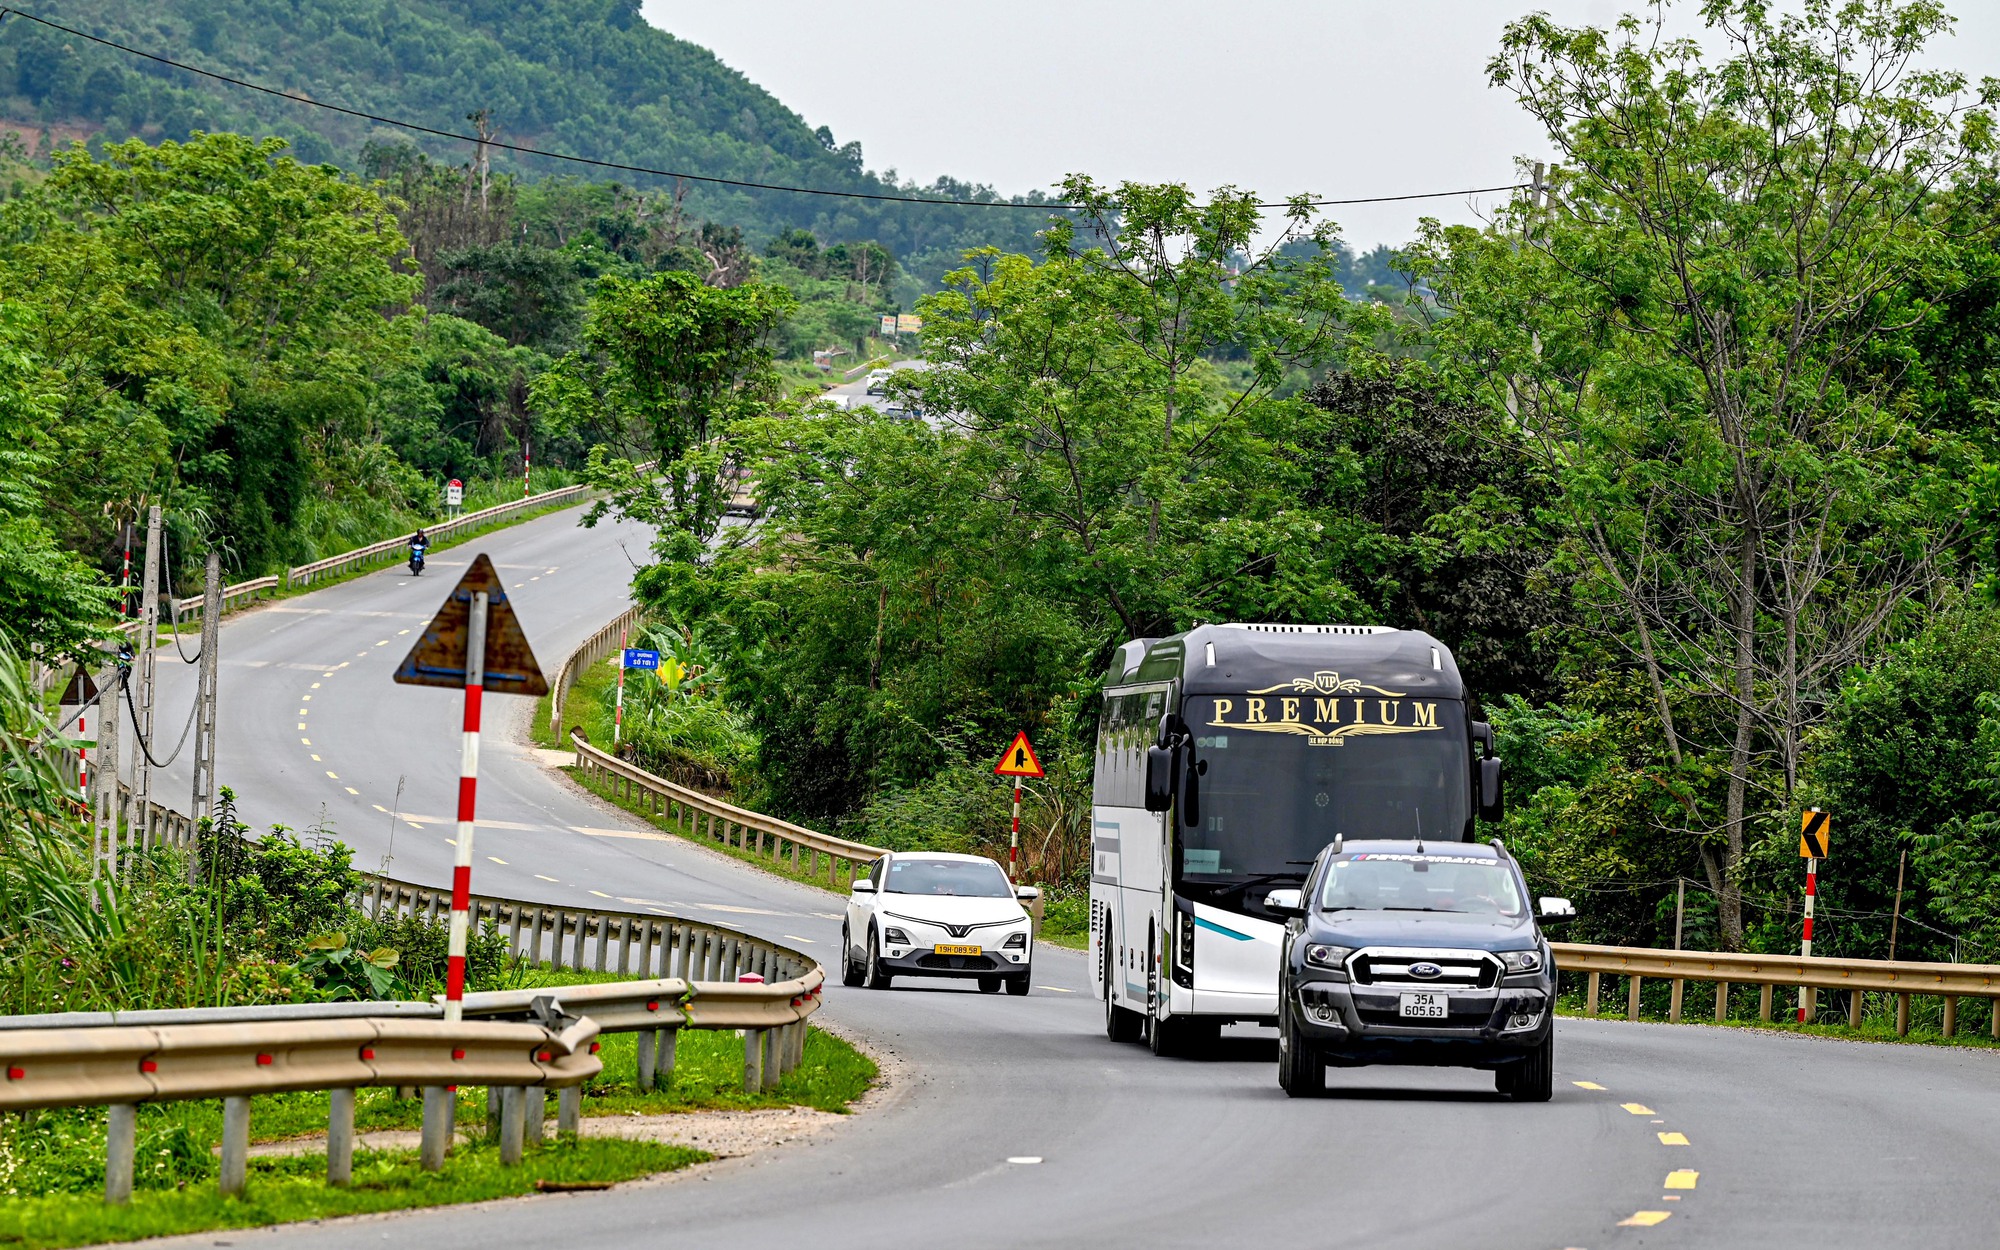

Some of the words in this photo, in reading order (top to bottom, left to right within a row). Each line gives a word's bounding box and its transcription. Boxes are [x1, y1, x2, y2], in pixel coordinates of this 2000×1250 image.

[1317, 675, 1336, 688] VIP
[1213, 697, 1438, 727] PREMIUM
[1365, 853, 1498, 866] PERFORMANCE
[1415, 965, 1435, 974] Ford
[1414, 994, 1434, 1005] 35A
[1405, 1005, 1443, 1017] 605.63
